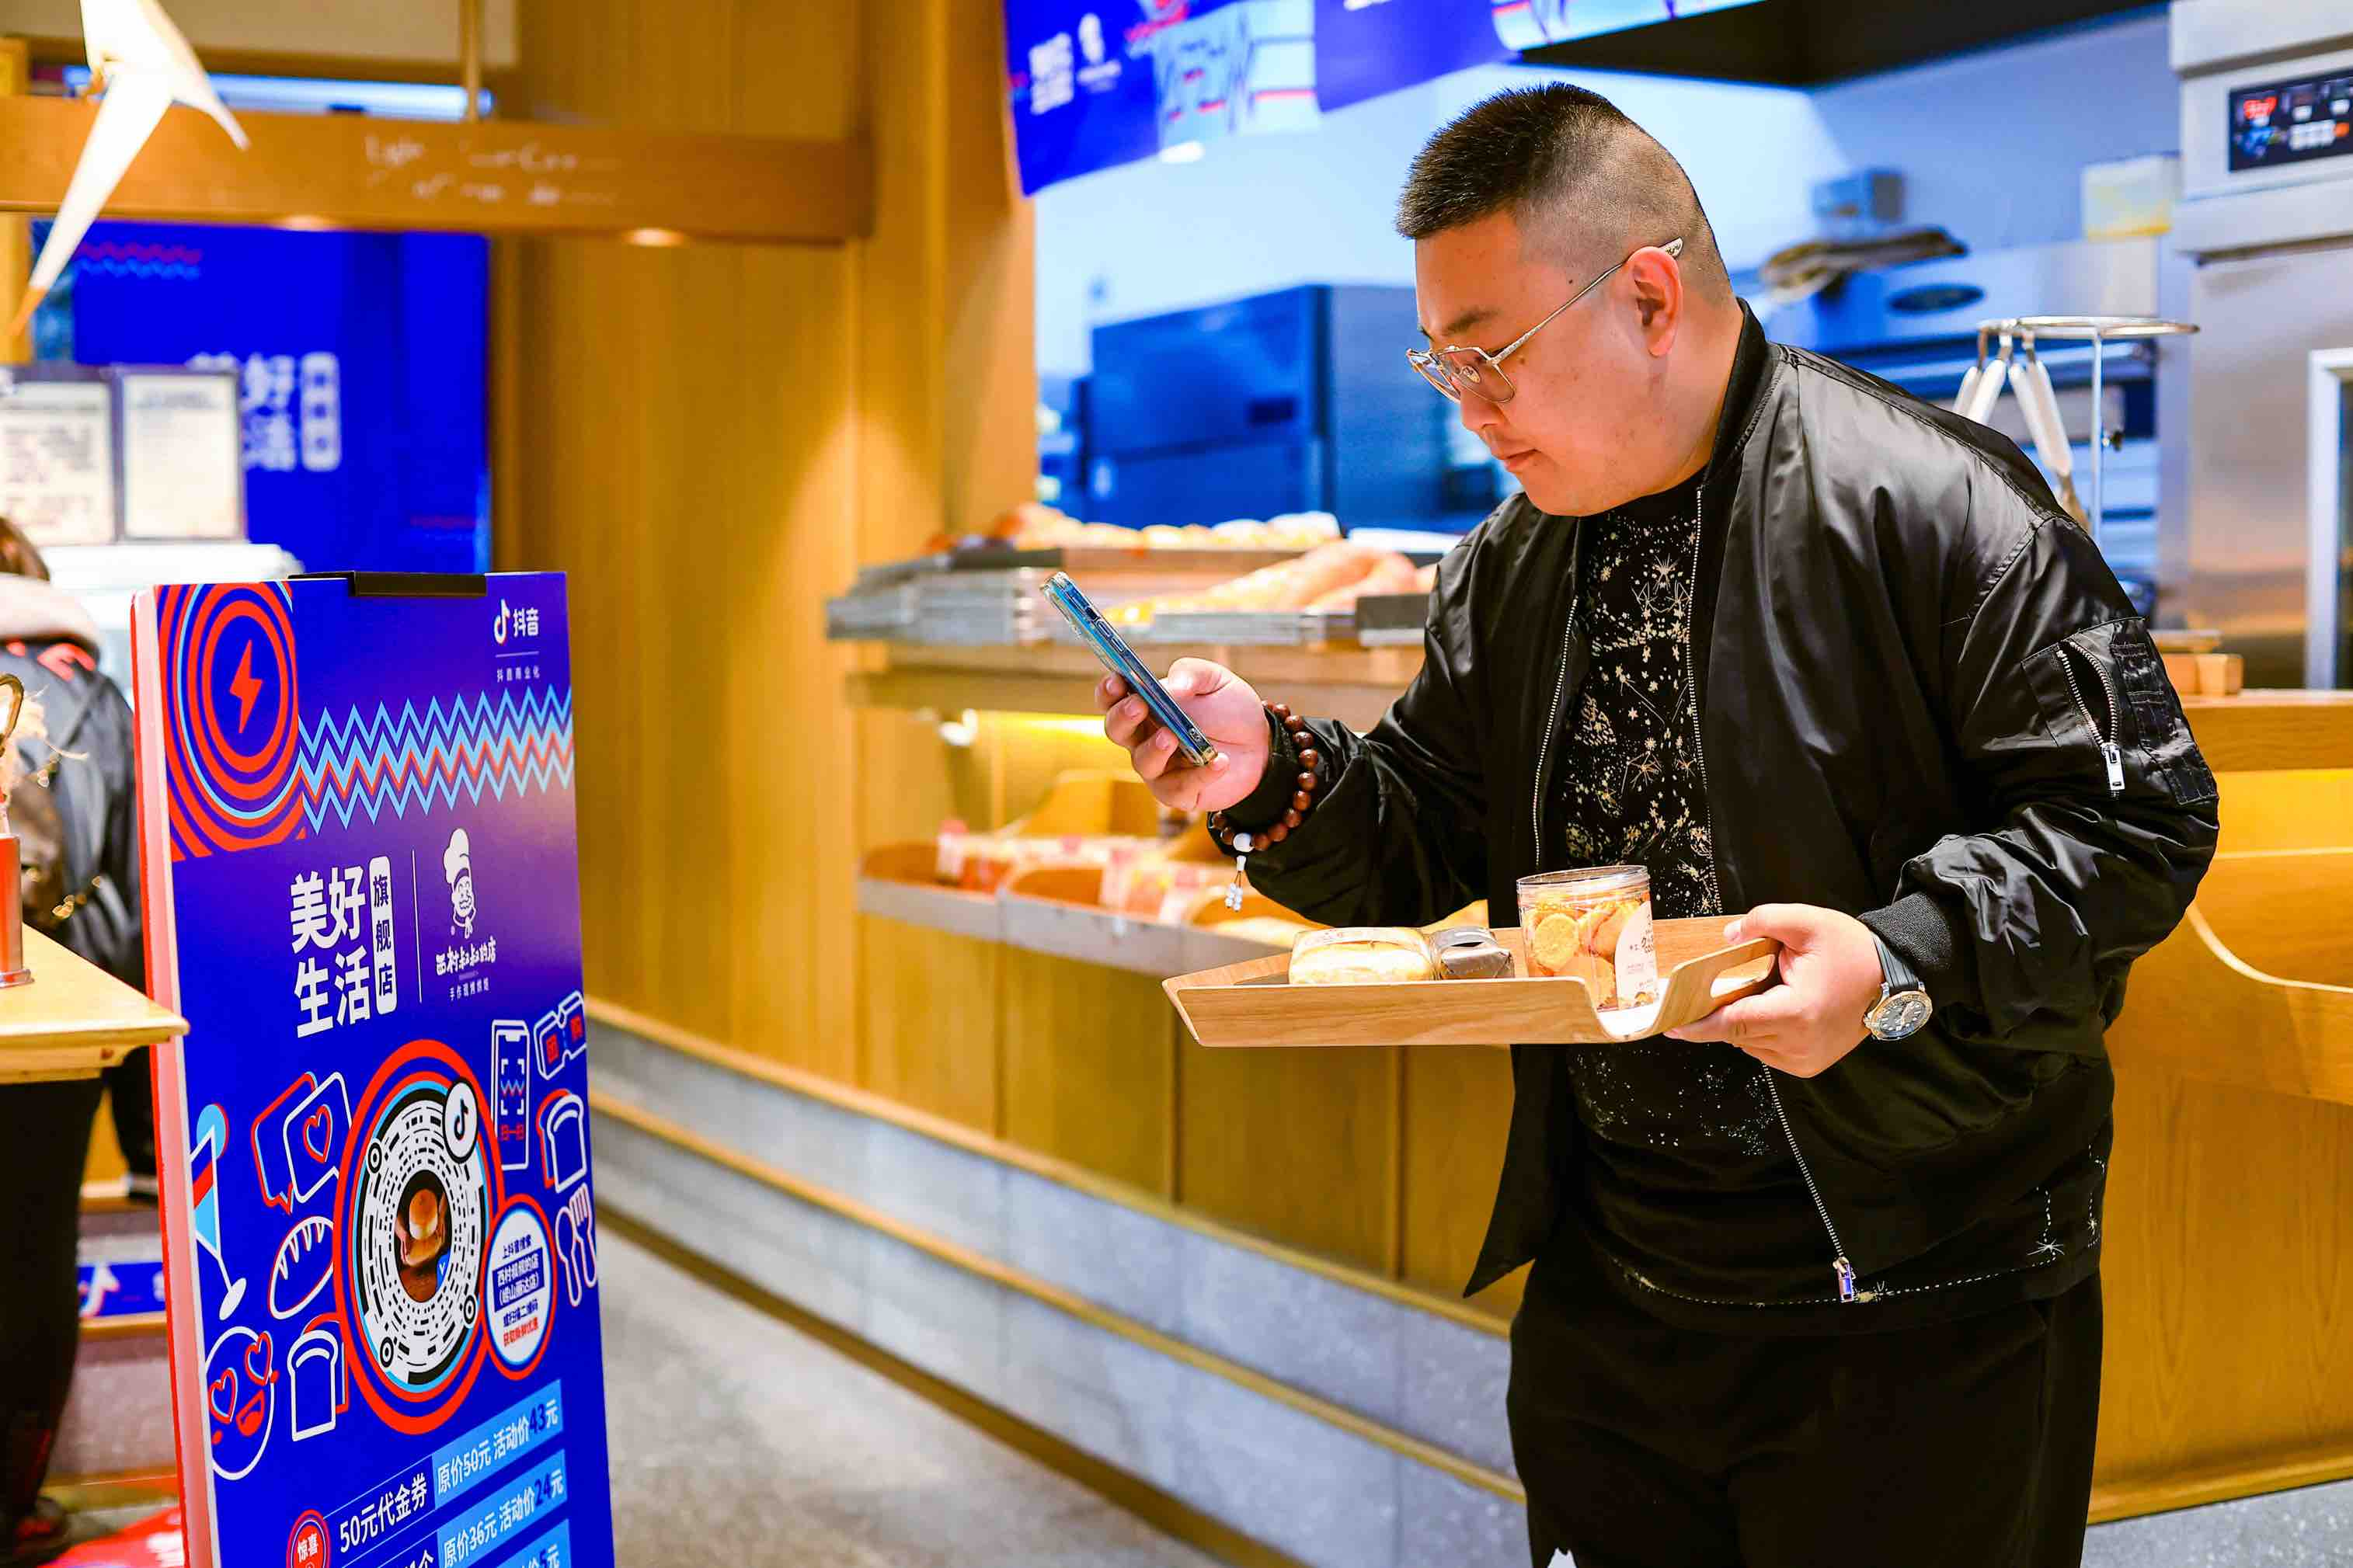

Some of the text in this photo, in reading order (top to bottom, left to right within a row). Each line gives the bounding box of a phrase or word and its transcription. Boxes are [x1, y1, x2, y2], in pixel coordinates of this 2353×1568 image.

[513, 607, 539, 637] 抖音
[291, 865, 366, 954] 美好
[373, 874, 393, 996] 旗舰店
[294, 945, 371, 1038] 生活
[340, 1399, 559, 1553] 50元代金券 原价50元 活动价43元
[444, 1469, 564, 1568] 原价36元 活动价24元
[298, 1533, 318, 1563] 惊喜
